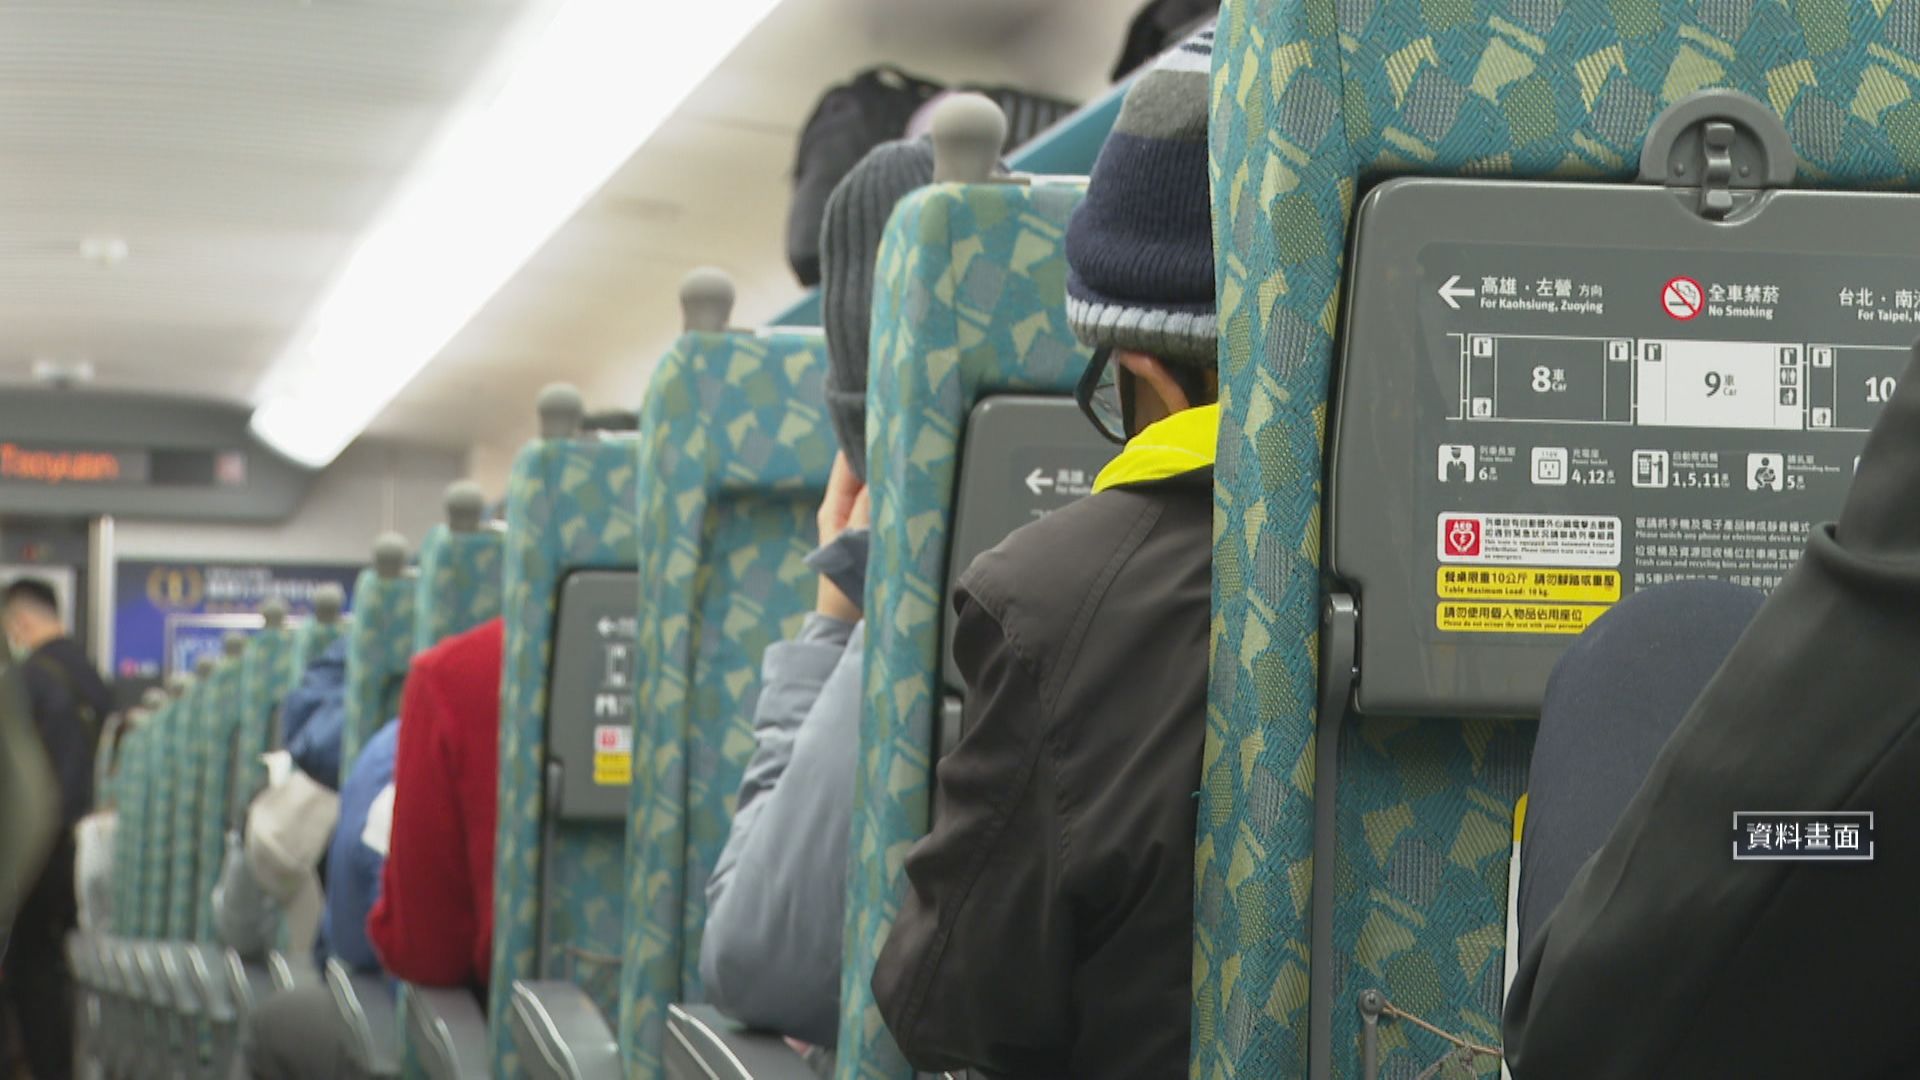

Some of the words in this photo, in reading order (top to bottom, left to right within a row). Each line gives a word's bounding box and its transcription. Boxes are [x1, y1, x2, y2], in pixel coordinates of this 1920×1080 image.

[1578, 284, 1603, 298] 方向
[1708, 284, 1780, 304] 全車禁菸
[1480, 298, 1496, 308] For
[1499, 298, 1558, 313] Kaohsiung,
[1560, 301, 1603, 314] Zuoying
[1708, 305, 1723, 316] No
[1725, 306, 1774, 320] Smoking
[1858, 310, 1875, 321] For
[1878, 310, 1912, 323] Taipei,
[1532, 365, 1551, 392] 8
[1552, 368, 1565, 382] 車
[1552, 382, 1567, 392] Car
[1704, 371, 1721, 397] 9
[1723, 387, 1737, 396] Car
[1865, 376, 1897, 402] 10
[0, 443, 119, 485] Taoyuan
[1479, 466, 1488, 480] 6
[1571, 469, 1605, 486] 4,12
[1672, 472, 1721, 488] 1,5,11
[1787, 475, 1796, 490] 5
[1453, 521, 1473, 530] AED
[1444, 585, 1464, 594] Table
[1467, 586, 1503, 595] Maximum
[1505, 587, 1526, 595] Load:
